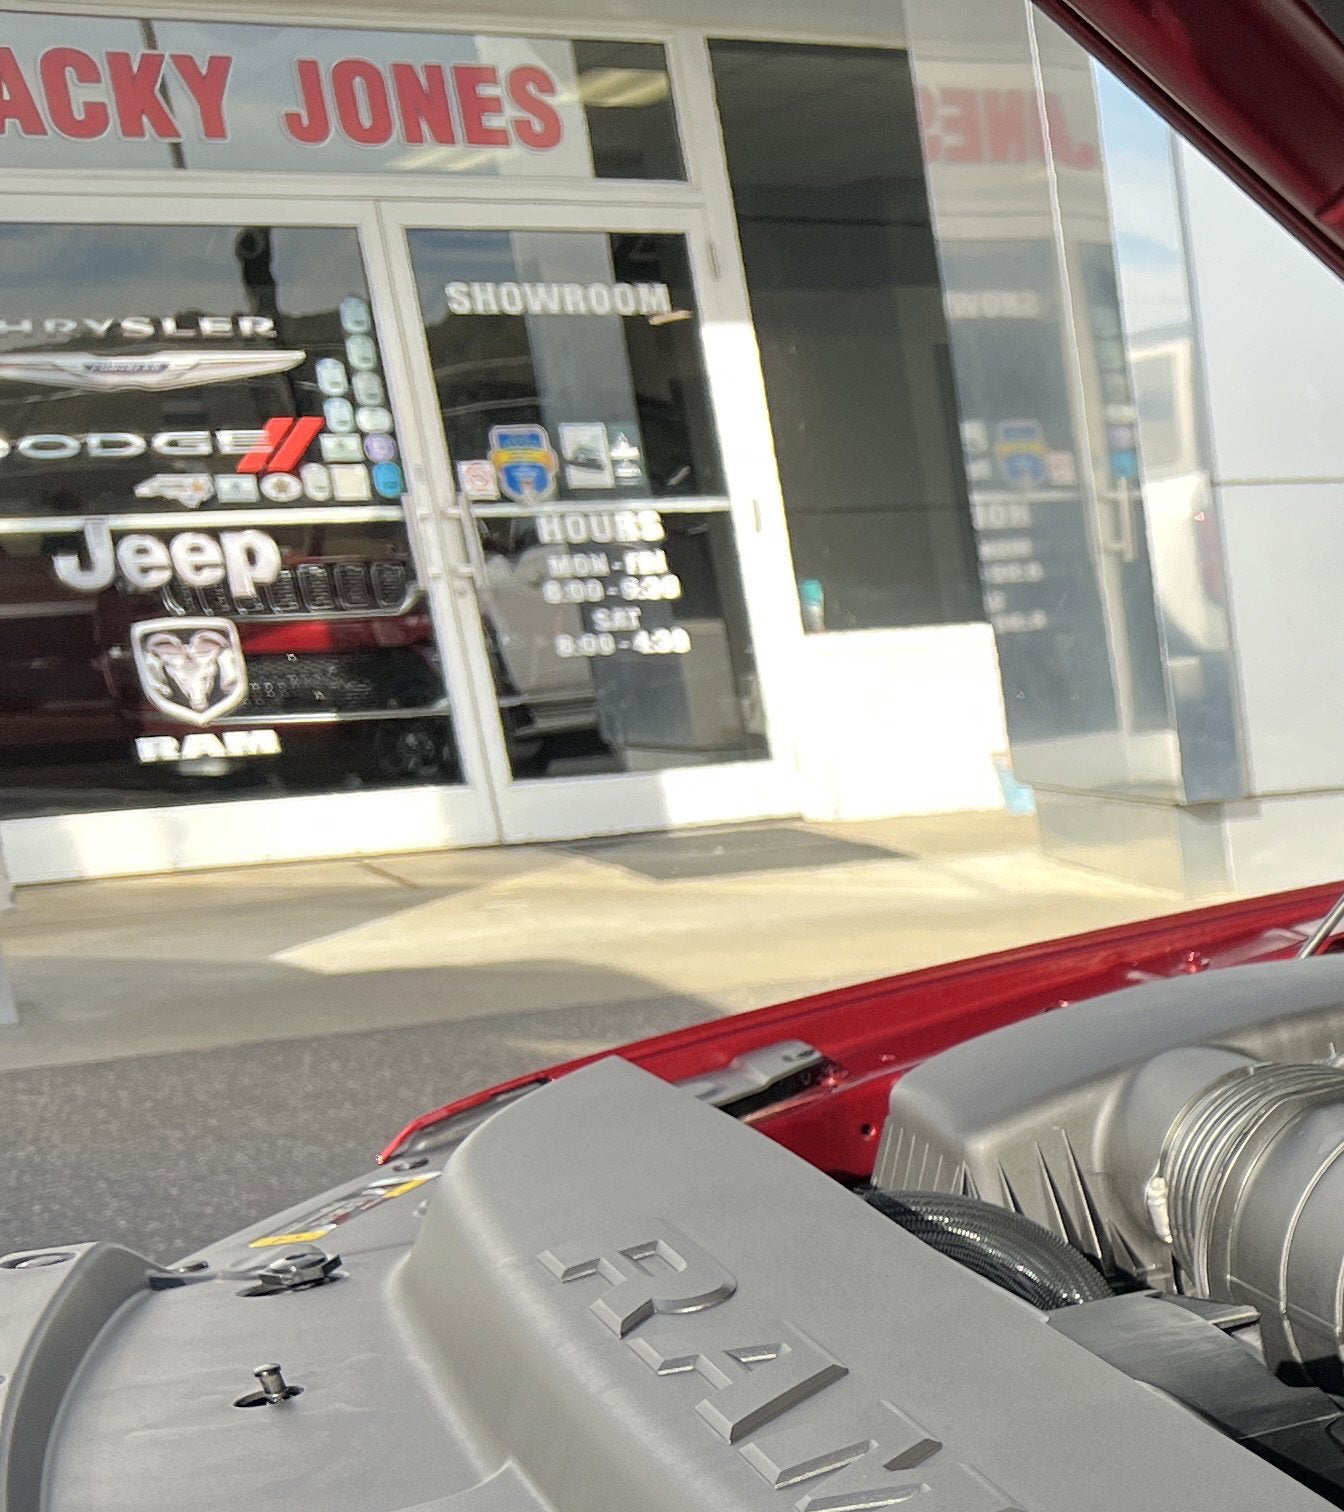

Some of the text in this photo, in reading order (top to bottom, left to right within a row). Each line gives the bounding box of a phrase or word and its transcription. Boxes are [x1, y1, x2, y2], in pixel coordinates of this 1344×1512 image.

[284, 58, 563, 150] JONES
[444, 281, 672, 316] SHOWROOM
[0, 429, 274, 460] ODGE
[536, 510, 666, 544] HOURS
[53, 517, 283, 599] Jeep
[135, 729, 282, 764] RAM
